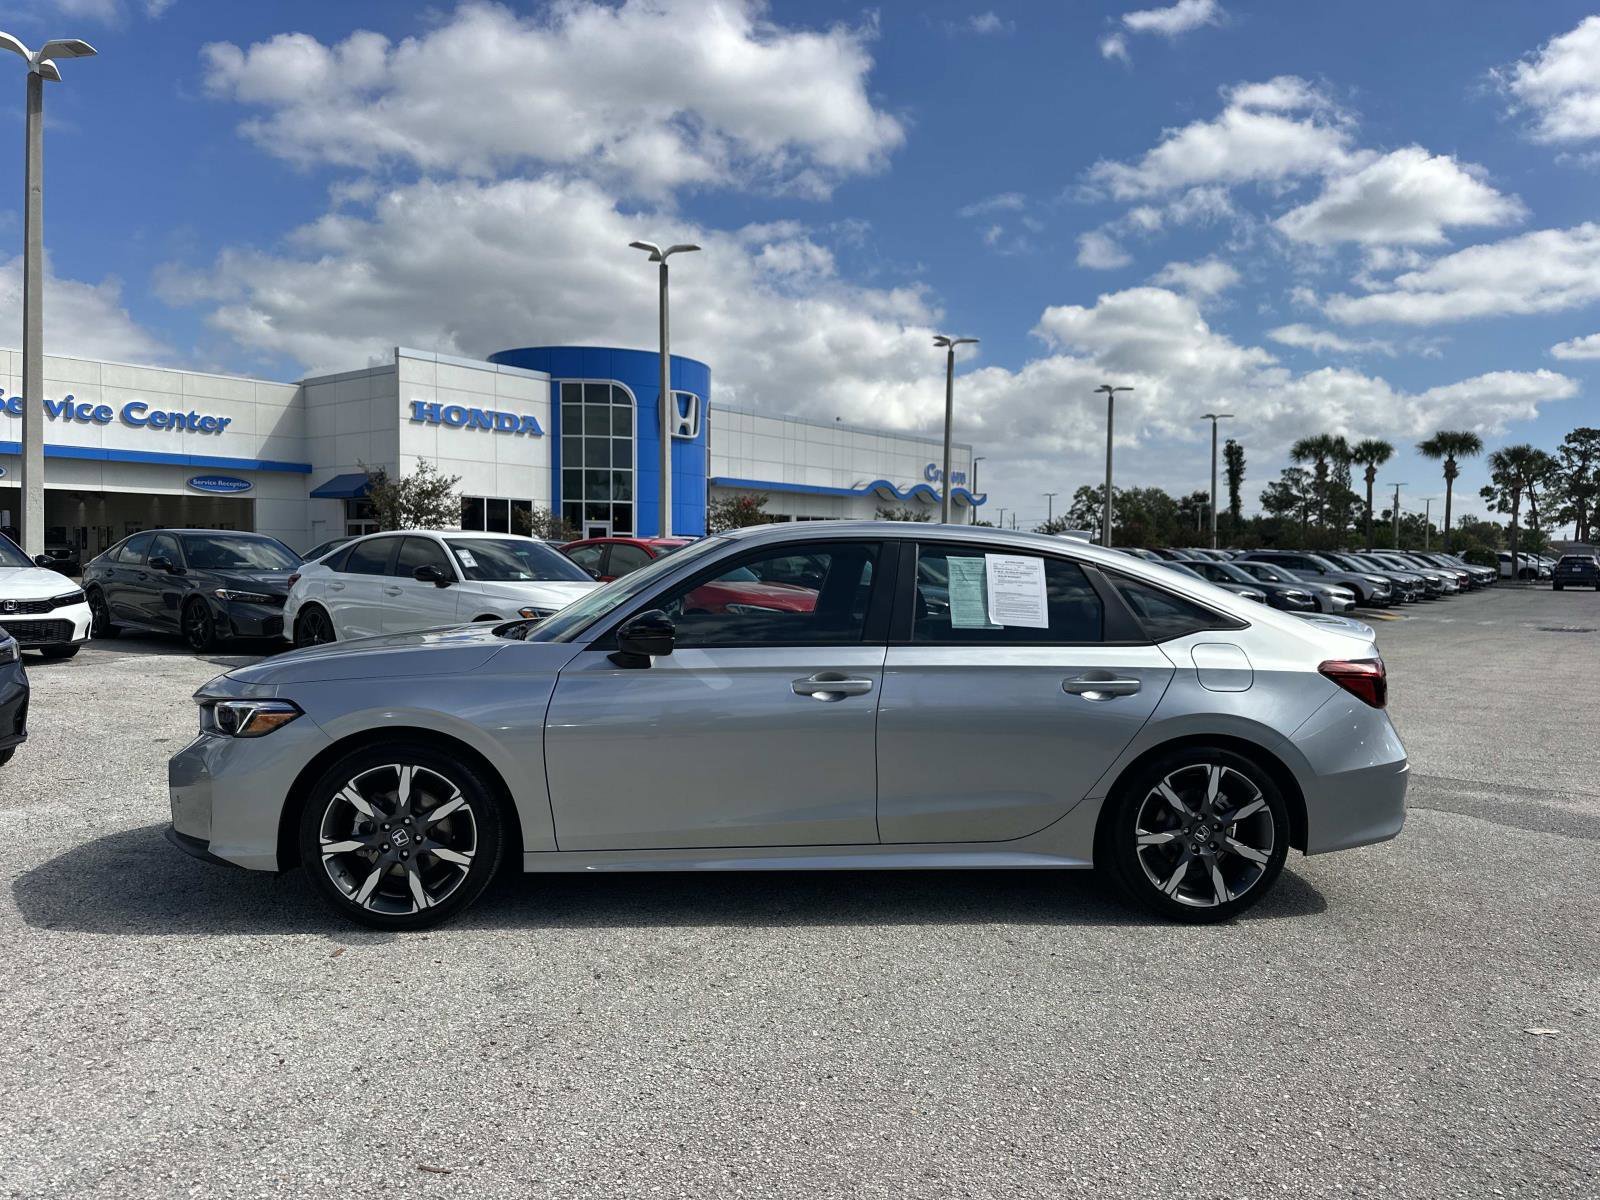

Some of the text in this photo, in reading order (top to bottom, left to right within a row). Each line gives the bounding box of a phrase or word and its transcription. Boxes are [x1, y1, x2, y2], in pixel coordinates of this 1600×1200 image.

[0, 388, 232, 433] evice Center
[409, 400, 545, 437] HONDA
